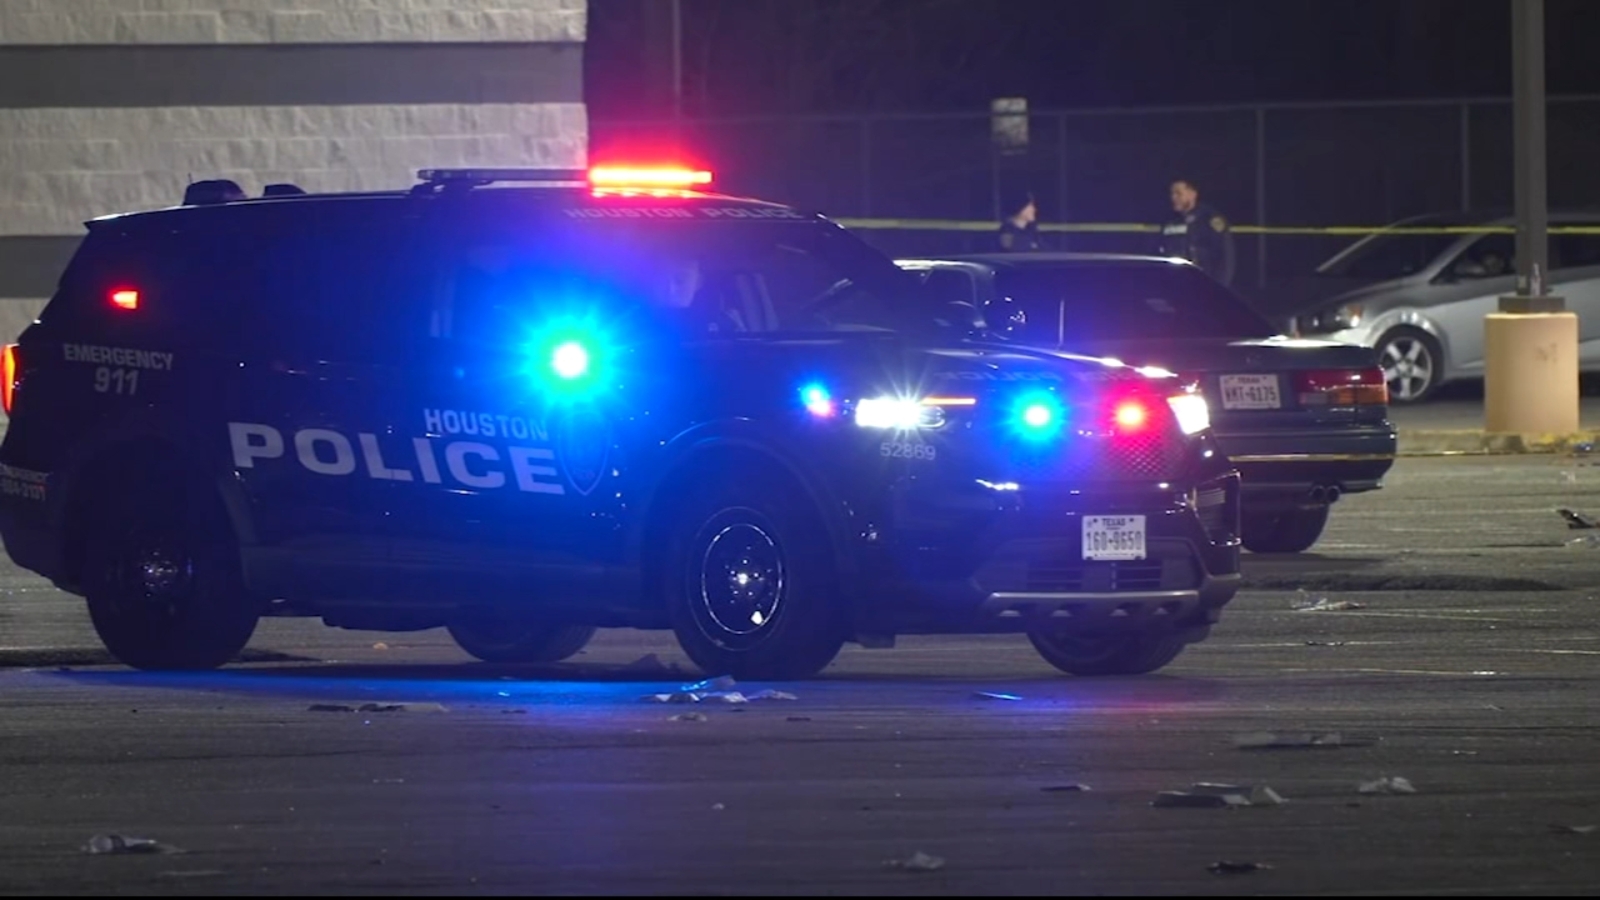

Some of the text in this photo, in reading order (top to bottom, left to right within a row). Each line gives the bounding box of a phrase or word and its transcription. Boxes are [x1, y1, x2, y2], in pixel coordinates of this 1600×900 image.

[562, 207, 805, 220] HOUSTON POLICE
[63, 343, 174, 371] EMERGENCY
[94, 366, 139, 395] 911
[424, 407, 550, 442] HOUSTON
[227, 421, 566, 495] POLICE
[880, 441, 936, 461] 52869
[1102, 517, 1126, 527] TEXAS
